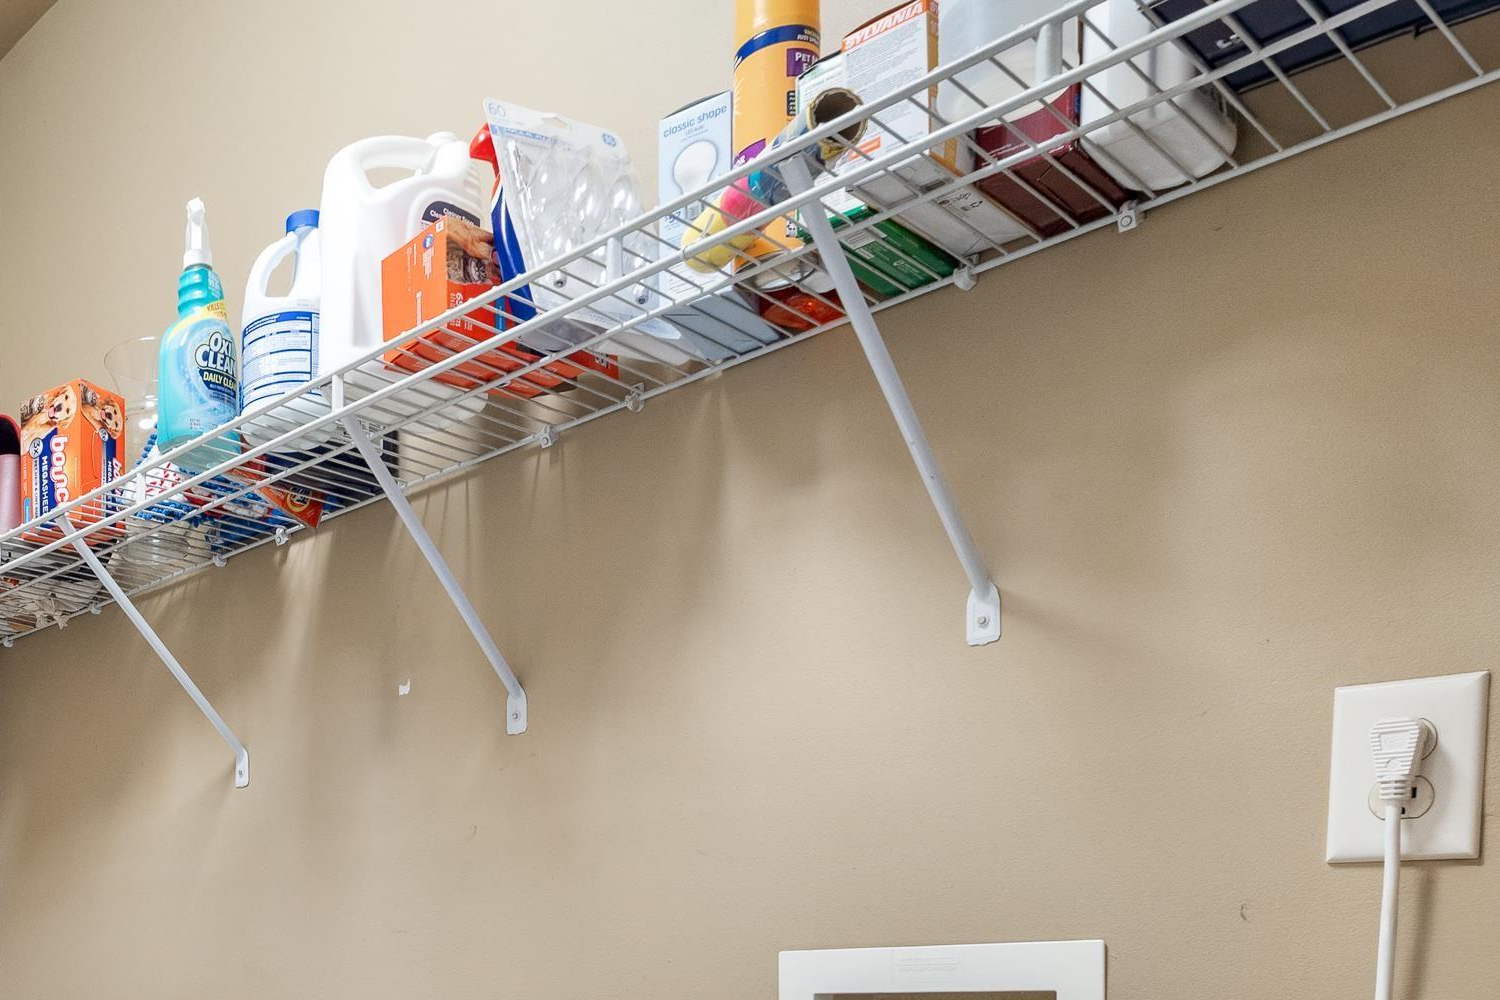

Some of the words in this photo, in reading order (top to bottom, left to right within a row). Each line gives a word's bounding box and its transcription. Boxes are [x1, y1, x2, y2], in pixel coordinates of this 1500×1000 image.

[844, 3, 922, 50] SYLVANIA
[795, 52, 811, 62] PET
[663, 119, 695, 138] classic
[697, 105, 727, 124] shape
[209, 331, 232, 356] OXI
[203, 371, 223, 384] DAILY
[223, 376, 237, 389] CLEA
[41, 456, 49, 514] MEGASHEE
[49, 436, 69, 503] bounc
